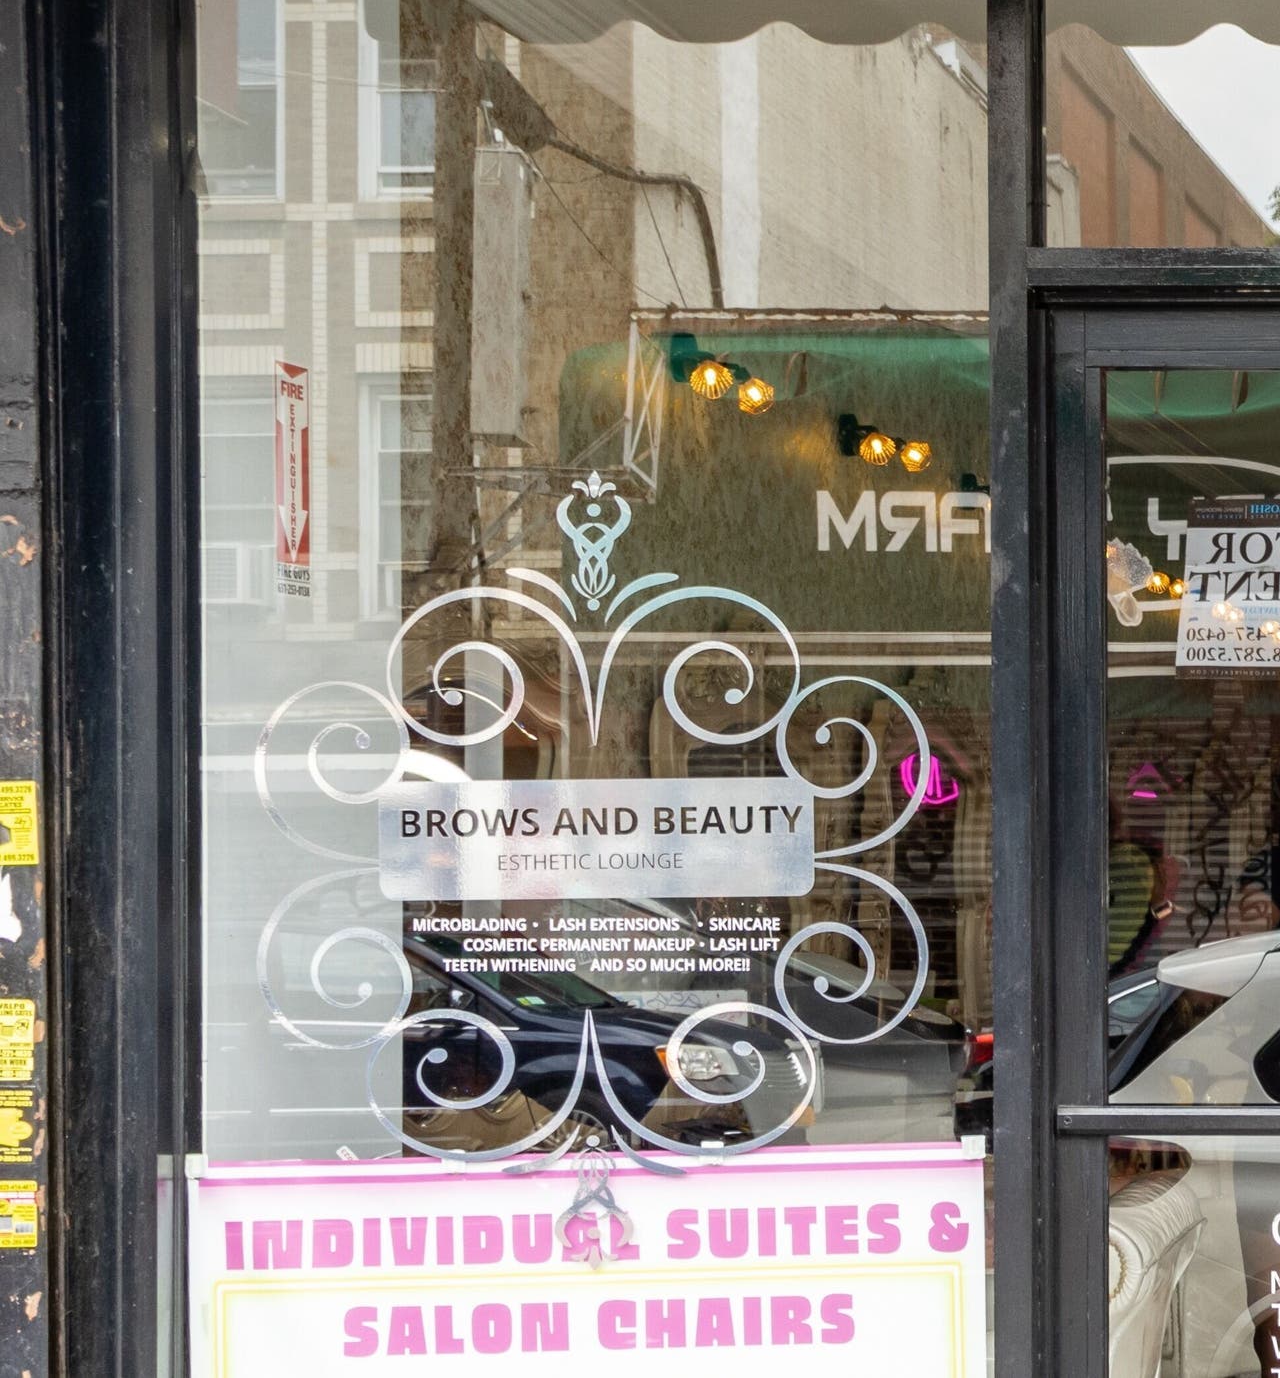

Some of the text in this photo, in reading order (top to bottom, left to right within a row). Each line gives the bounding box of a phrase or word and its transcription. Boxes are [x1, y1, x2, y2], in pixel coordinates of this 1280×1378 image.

[280, 380, 304, 401] FIRE
[401, 805, 803, 838] BROWS AND BEAUTY
[498, 853, 683, 871] ESTHETIC LOUNGE
[413, 917, 780, 932] MICROBLADING LASH EXTENSIONS SKINCARE
[464, 938, 780, 952] COSMETIC PERMANENT MAKEUP LASH LIFT
[443, 958, 751, 973] TEETH WITHENING AND SO MUCH MORE!!
[666, 1203, 900, 1259] SUITES
[928, 1201, 969, 1254] &
[343, 1293, 856, 1357] SALON CHAIRS
